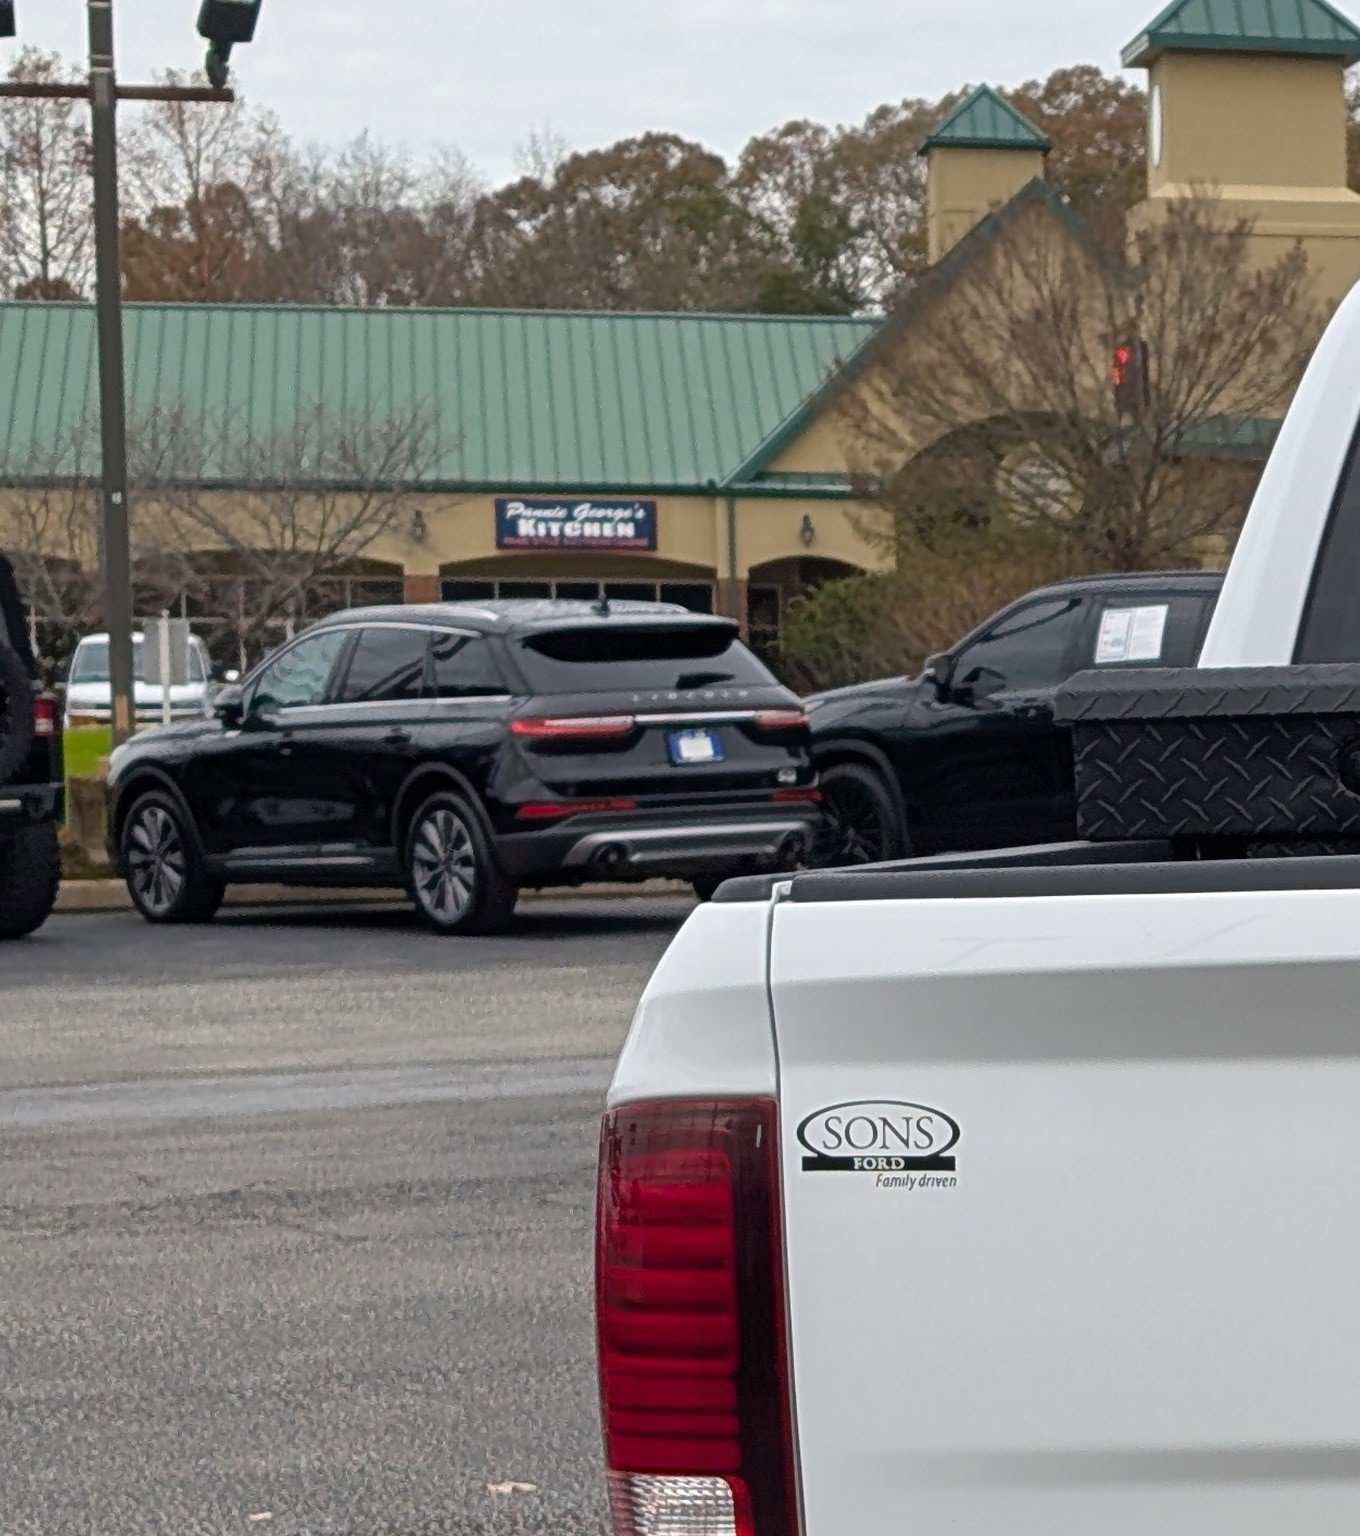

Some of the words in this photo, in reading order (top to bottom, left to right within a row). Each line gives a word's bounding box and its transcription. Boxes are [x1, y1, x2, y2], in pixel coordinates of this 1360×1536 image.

[518, 519, 635, 537] KITCHEN
[822, 1116, 934, 1150] SONS
[853, 1157, 905, 1170] FORD
[875, 1174, 920, 1191] Family
[919, 1174, 957, 1188] driven
